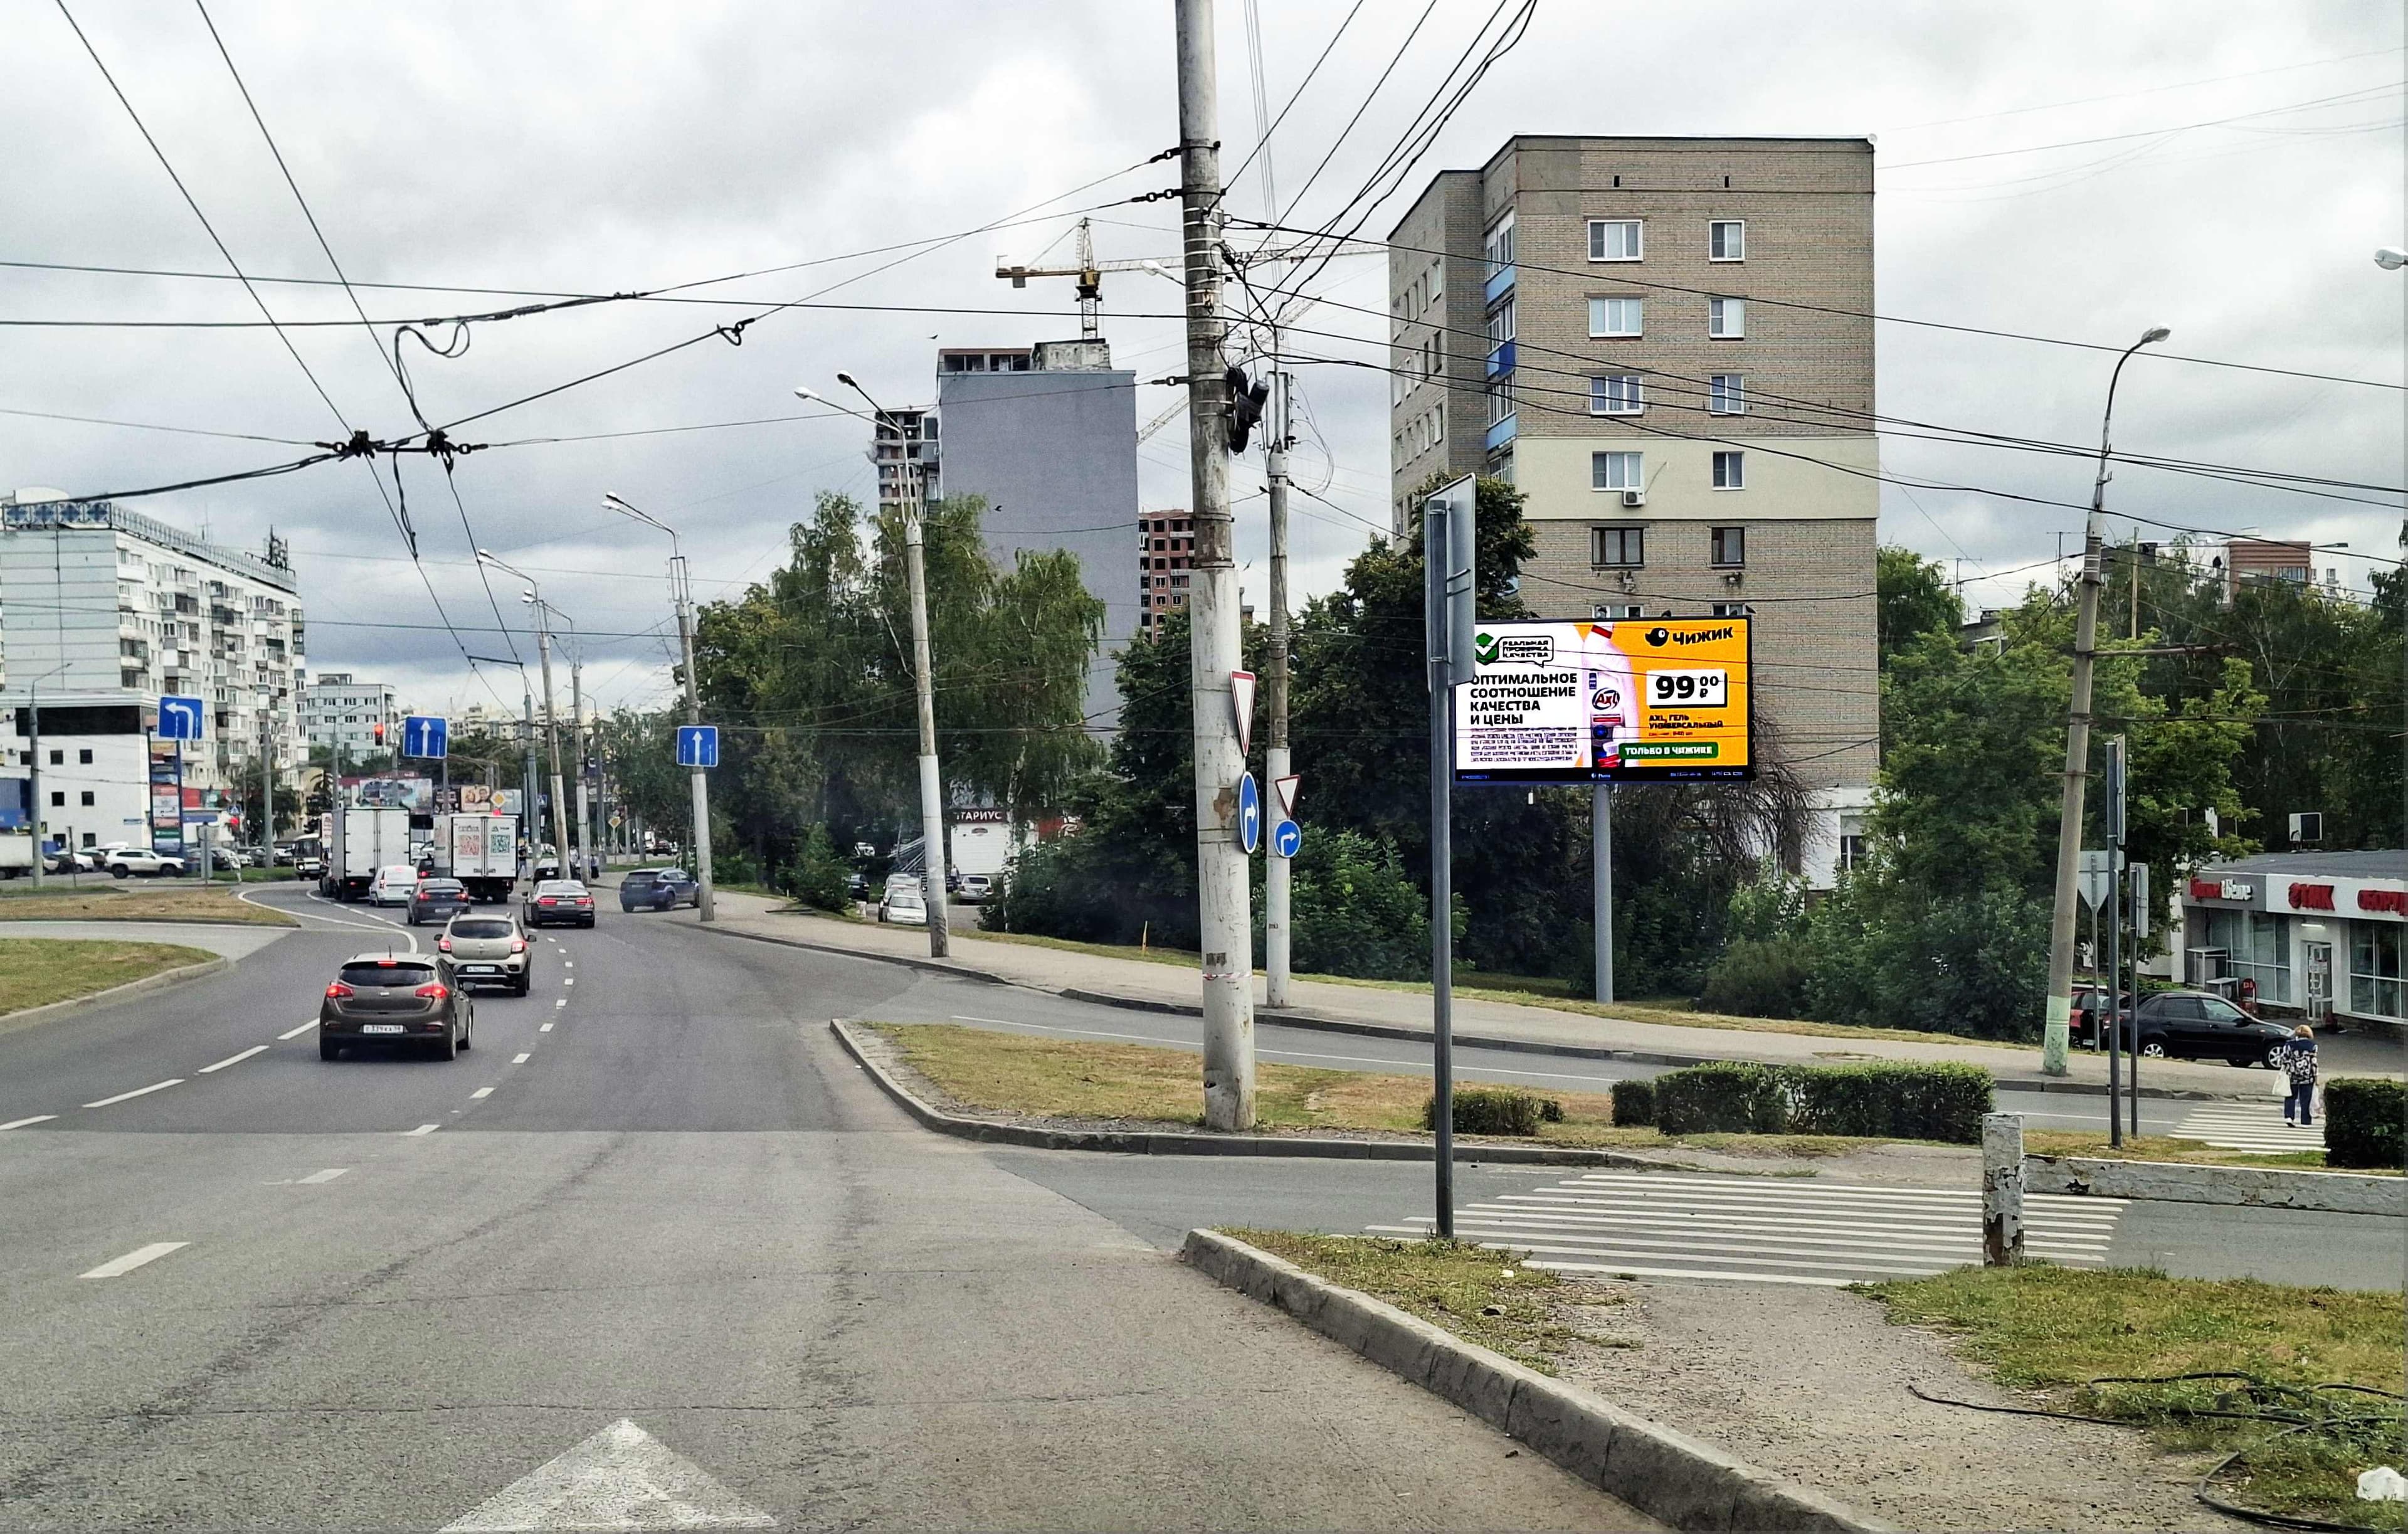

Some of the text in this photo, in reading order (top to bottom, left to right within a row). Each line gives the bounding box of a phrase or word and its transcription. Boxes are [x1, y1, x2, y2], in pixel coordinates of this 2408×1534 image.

[1672, 627, 1733, 645] ЧИЖИК
[1472, 673, 1577, 685] ОПТИМАЛЬНОЕ
[1470, 687, 1576, 698] СООТНОШЕНИЕ
[1656, 675, 1719, 699] 99 00
[1470, 701, 1541, 711] КАЧЕСТВА
[1470, 714, 1523, 726] И ЦЕНЫ
[1625, 746, 1662, 755] ТОЛЬКО
[1672, 746, 1713, 754] ЧИЖИКЕ
